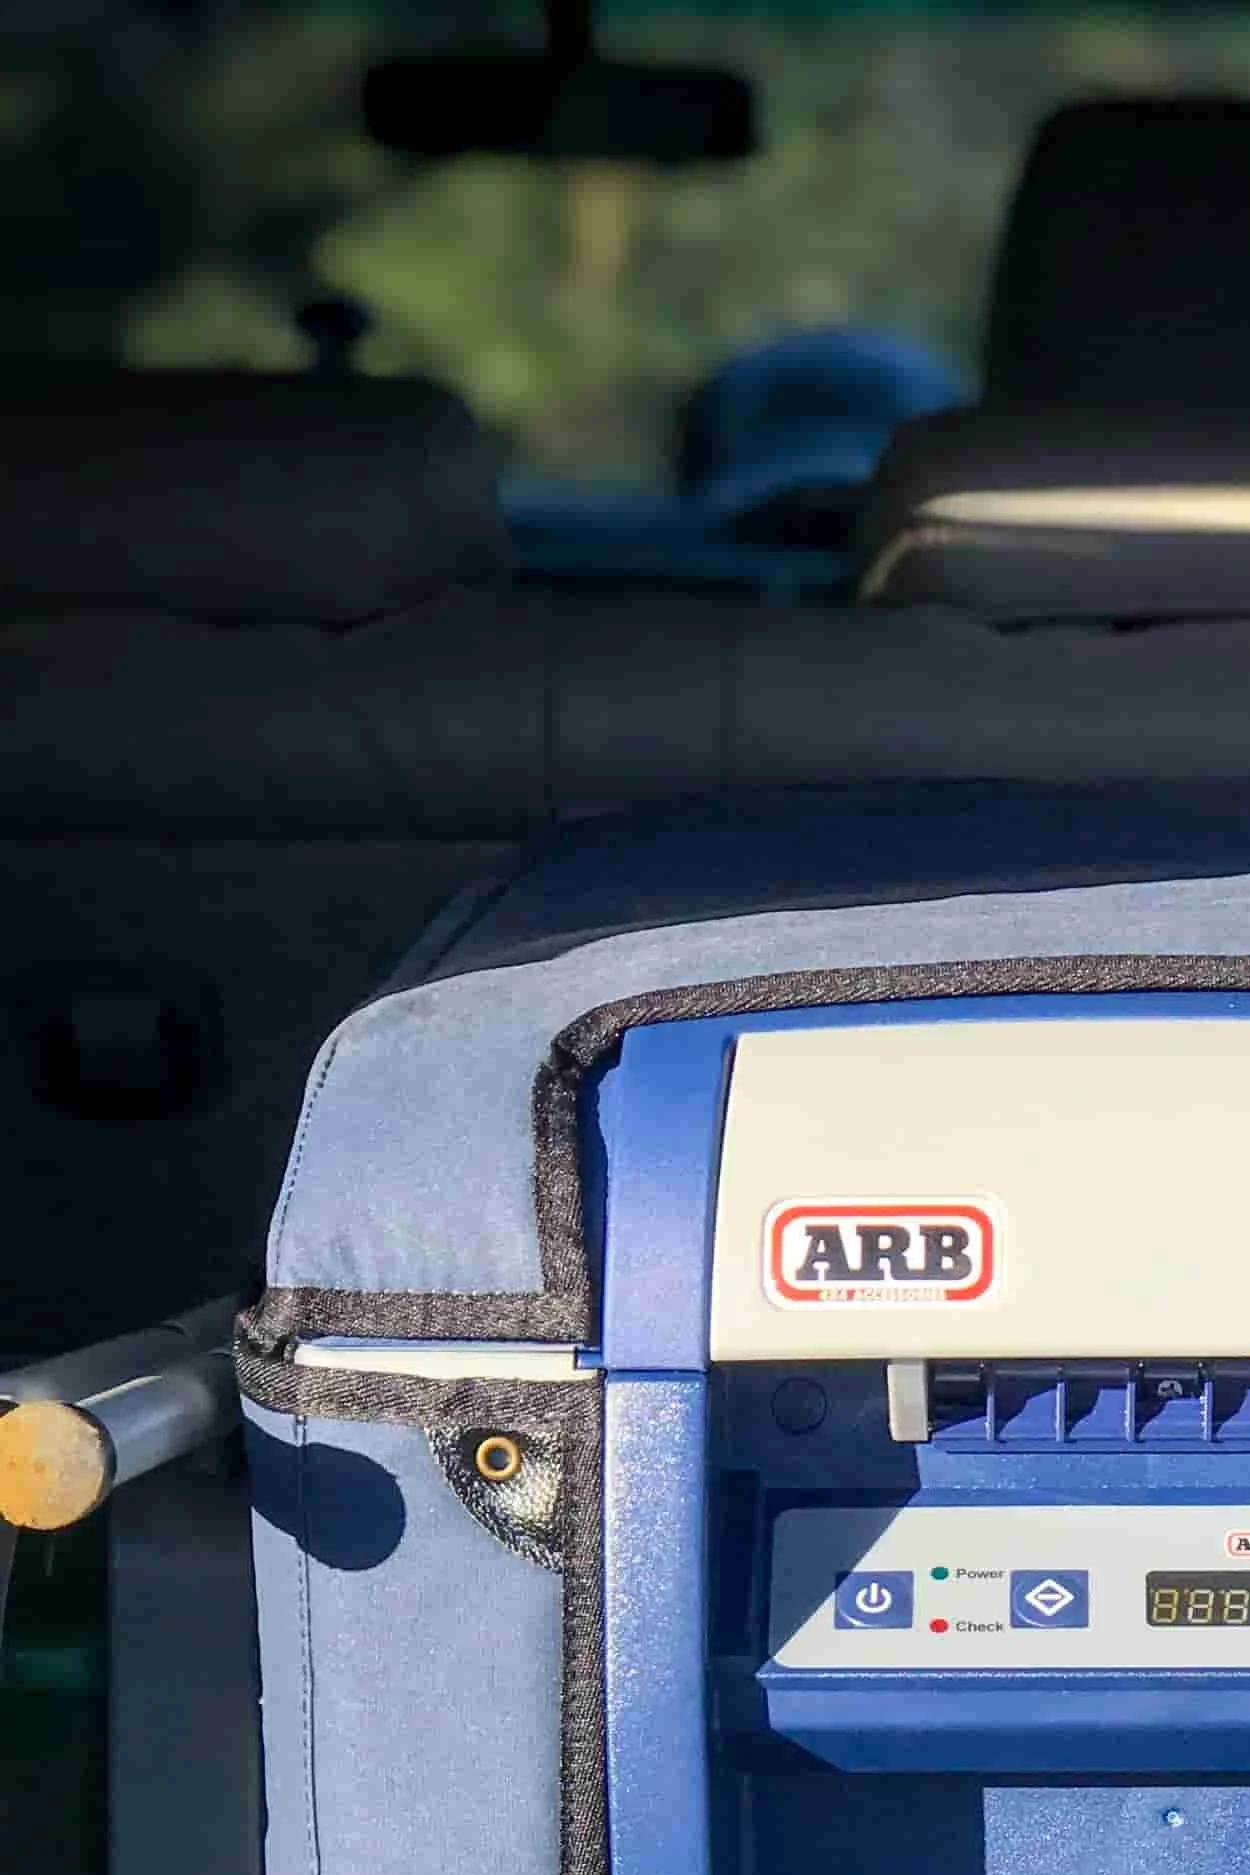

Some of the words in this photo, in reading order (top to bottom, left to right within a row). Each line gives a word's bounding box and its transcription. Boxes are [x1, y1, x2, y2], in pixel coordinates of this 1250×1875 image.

[795, 1224, 973, 1281] ARB
[955, 1567, 1004, 1580] Power
[955, 1619, 1004, 1633] Check
